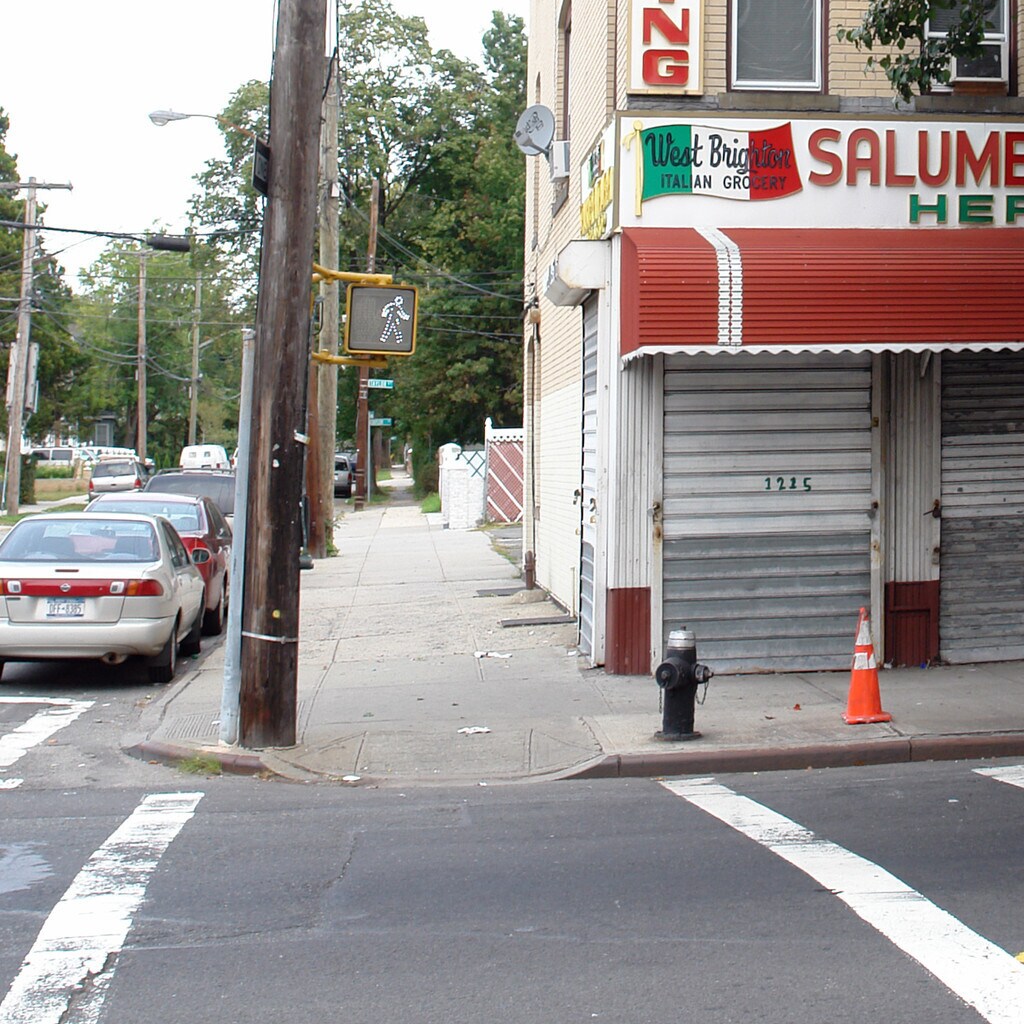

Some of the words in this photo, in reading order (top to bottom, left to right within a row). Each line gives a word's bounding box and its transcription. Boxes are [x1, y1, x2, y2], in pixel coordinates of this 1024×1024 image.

[645, 131, 703, 168] West
[709, 134, 792, 174] Brighton
[661, 174, 712, 189] ITALIAN
[723, 175, 787, 190] GROCERY
[765, 477, 812, 492] 1215
